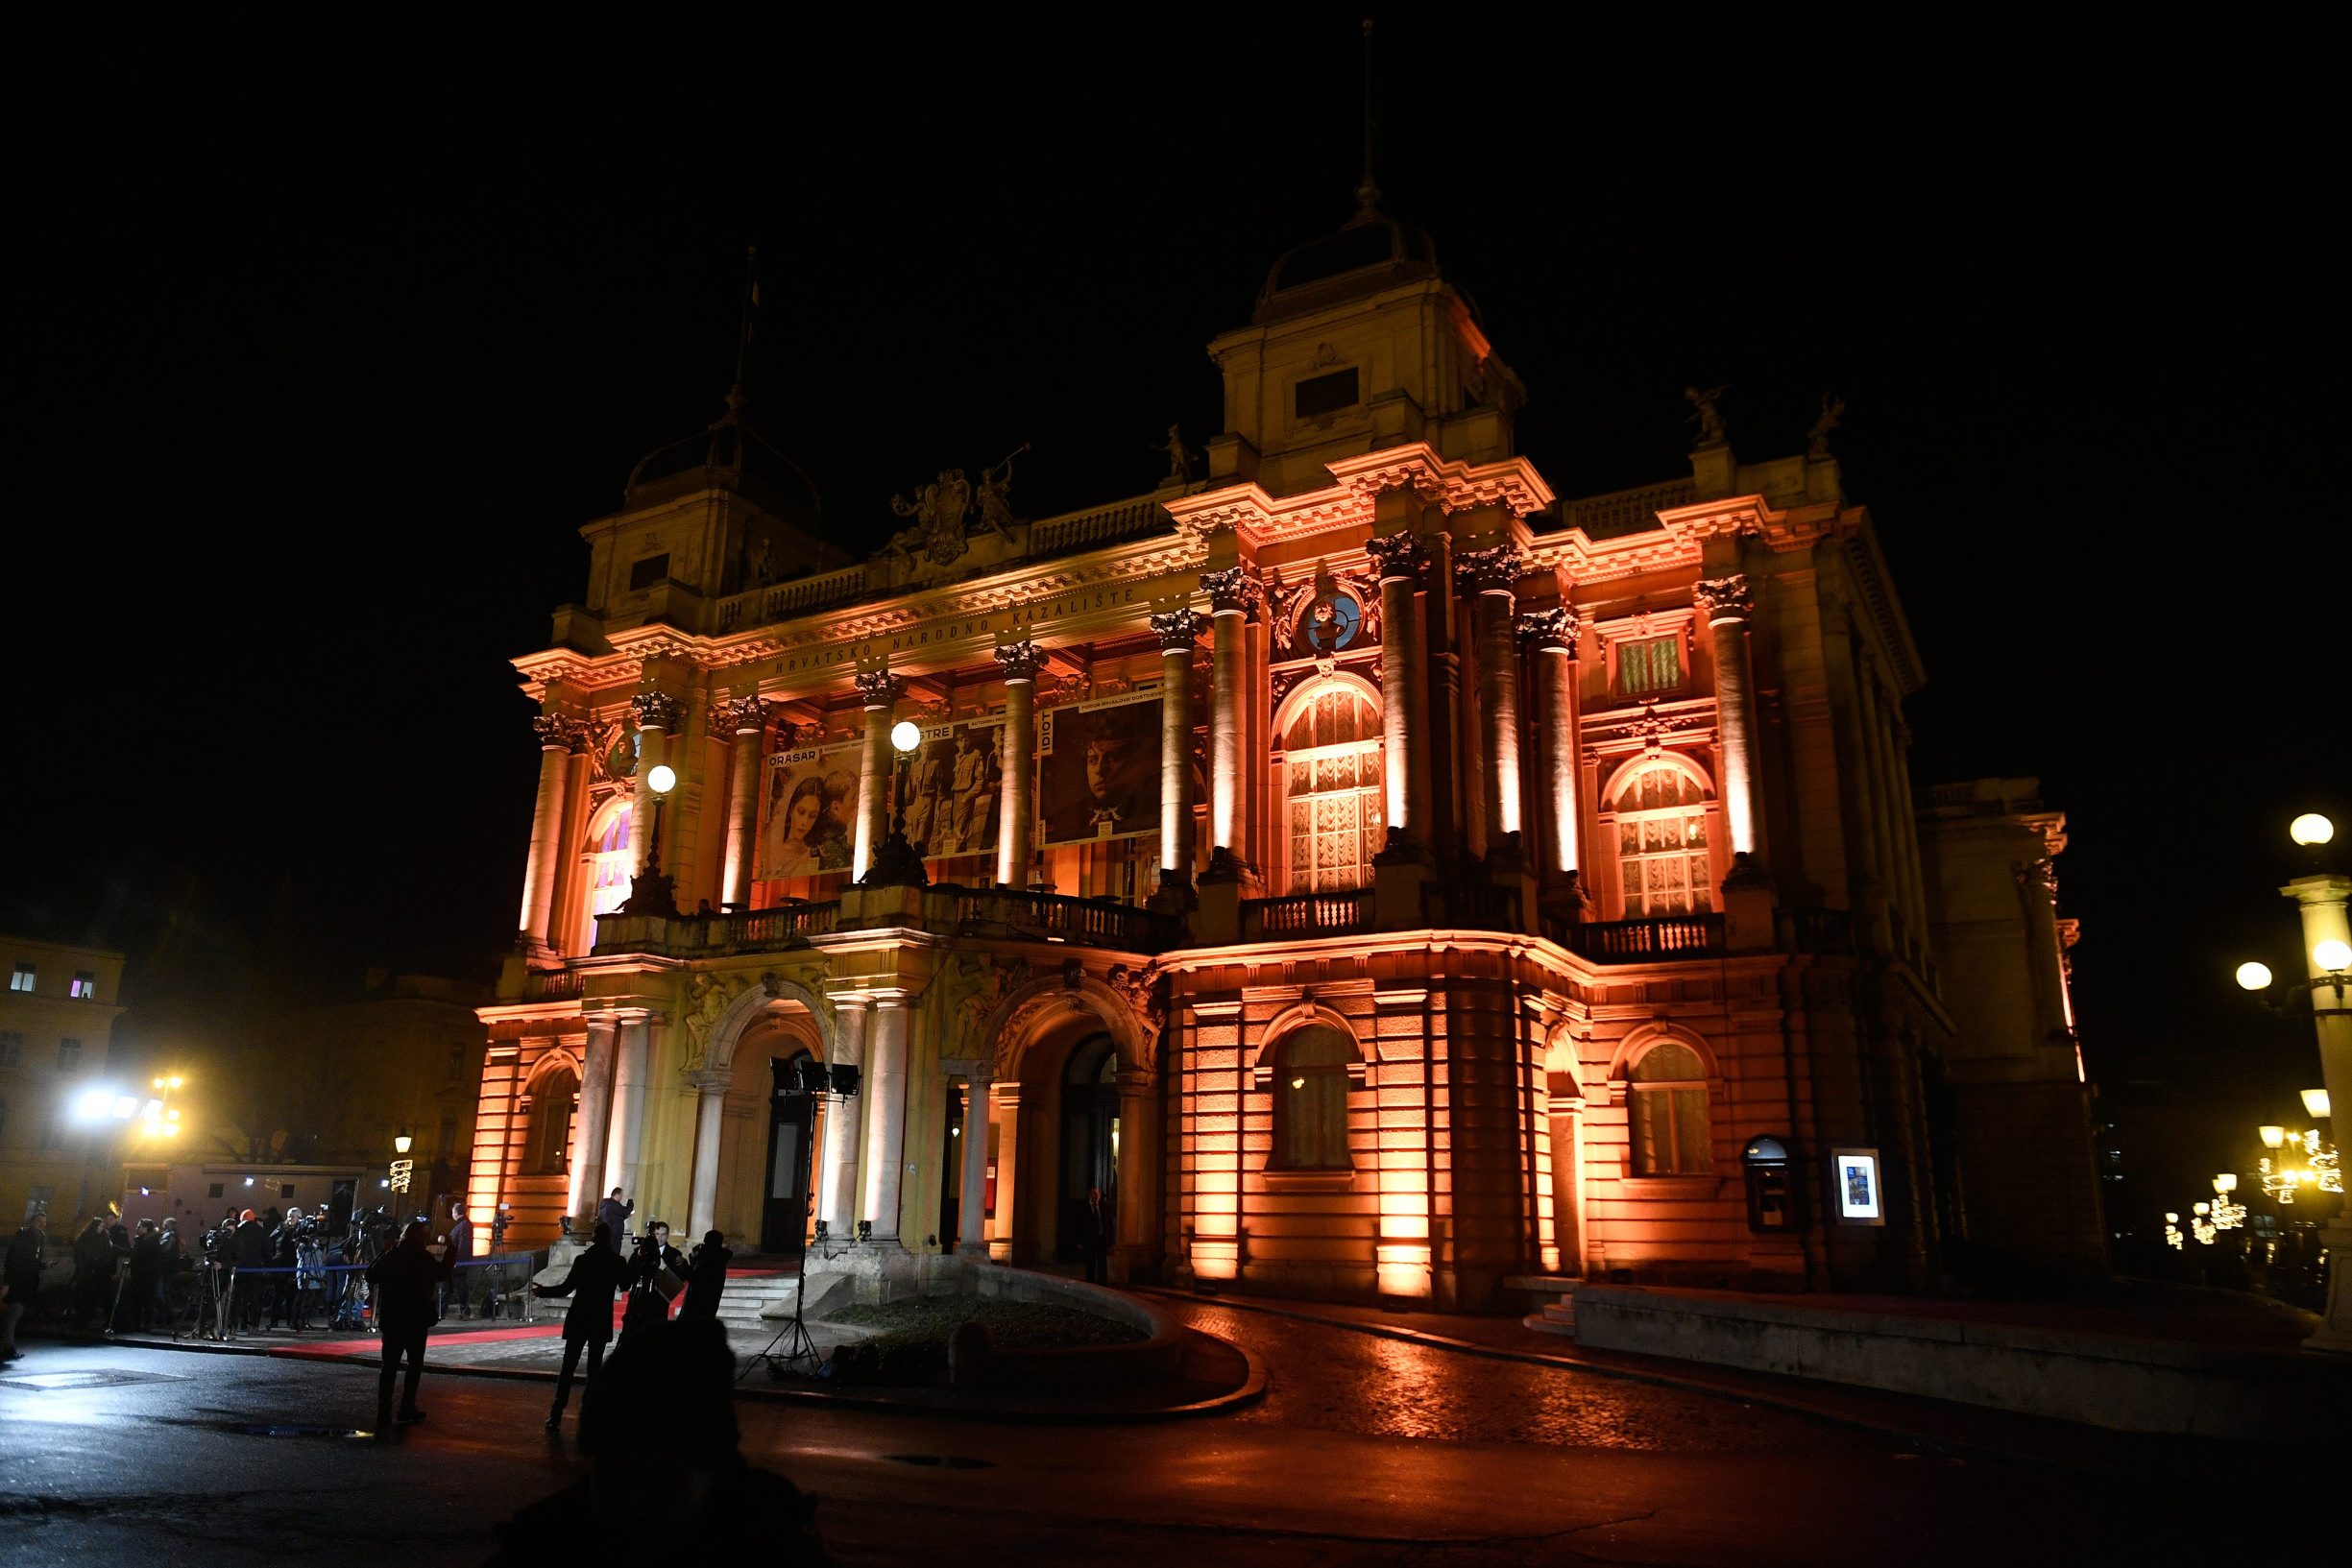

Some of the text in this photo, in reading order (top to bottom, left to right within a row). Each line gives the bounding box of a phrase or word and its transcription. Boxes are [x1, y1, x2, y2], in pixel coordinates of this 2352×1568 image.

[775, 589, 1133, 674] HRVATSKO NARODNO KAZALIŠTE
[920, 727, 950, 740] STRE
[1041, 712, 1051, 751] IDIOT
[769, 751, 816, 766] ORASAR
